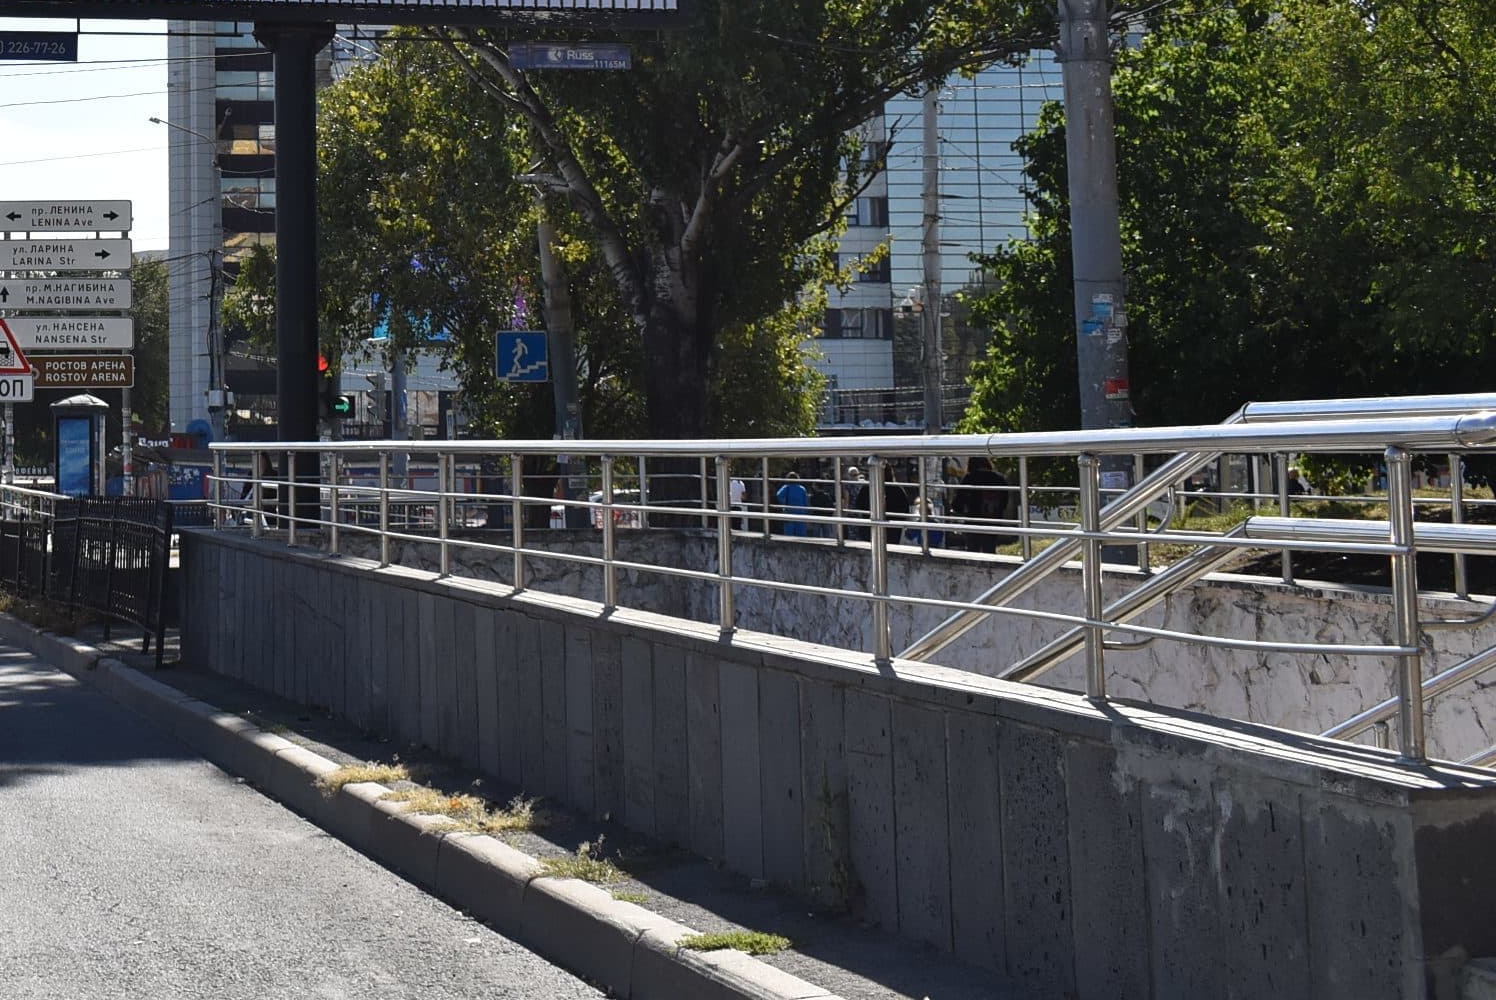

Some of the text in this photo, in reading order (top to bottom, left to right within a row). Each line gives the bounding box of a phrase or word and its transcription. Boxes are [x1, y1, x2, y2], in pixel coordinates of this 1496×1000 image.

[9, 42, 67, 55] 226-77-26
[566, 48, 595, 61] Russ
[31, 205, 93, 217] пр. ЛЕНИНА
[31, 218, 93, 227] LENINA Ave
[12, 244, 74, 256] ул. ЛАРИНА
[12, 256, 76, 266] LARINA Str
[25, 283, 115, 295] пр. М.НАГИБИНА
[26, 295, 115, 305] M.NAGIBINA Ave
[35, 322, 105, 333] ул. НАНСЕНА
[35, 335, 107, 344] NANSENA Str
[45, 361, 126, 370] РОСТОВ АРЕНА
[45, 373, 126, 382] ROSTOV ARENA
[12, 465, 48, 475] ОФЕЙНЯ
